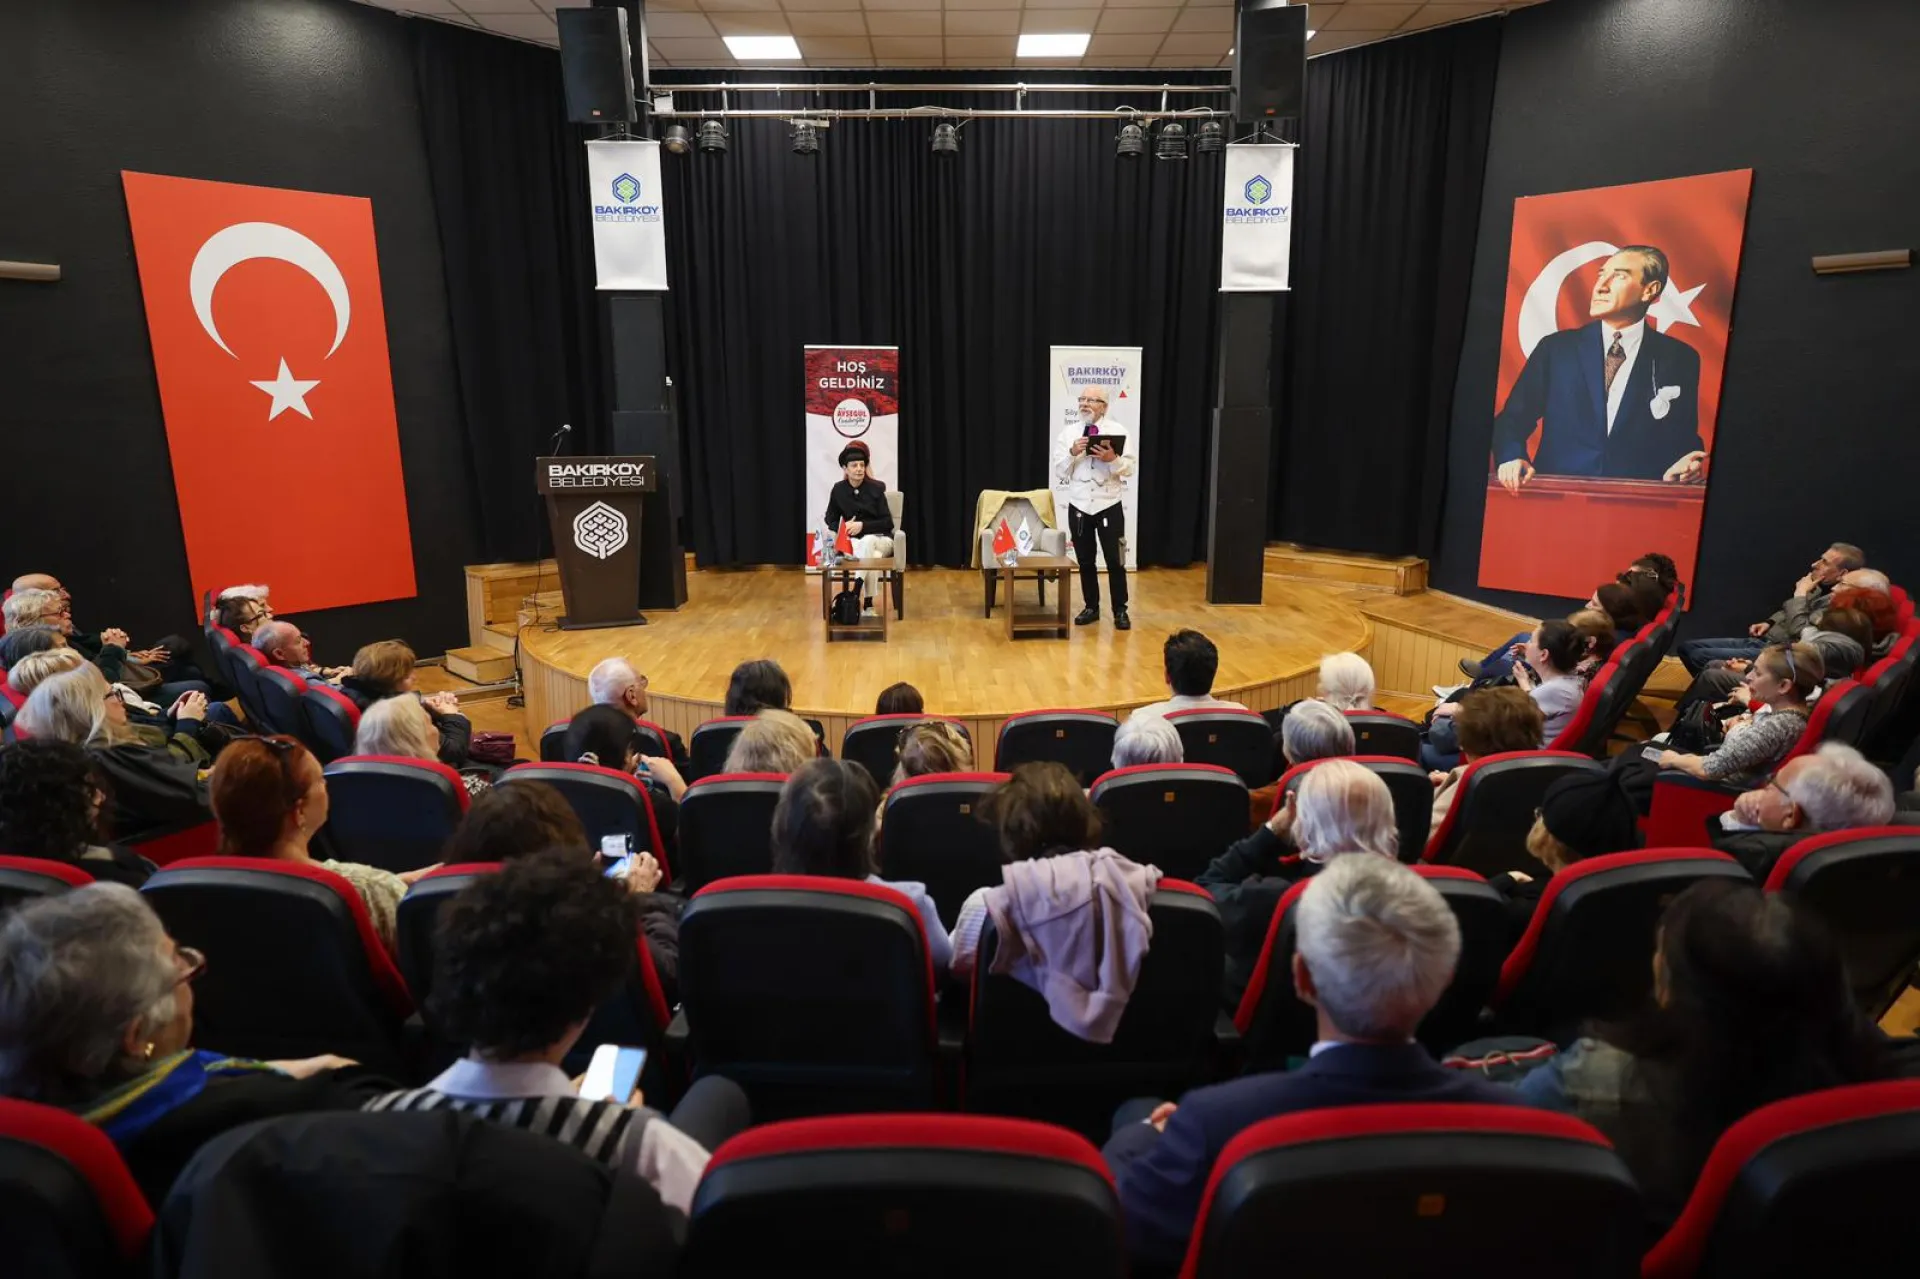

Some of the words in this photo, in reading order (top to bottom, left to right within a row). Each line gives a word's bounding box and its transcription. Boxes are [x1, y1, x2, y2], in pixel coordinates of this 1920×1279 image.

[837, 361, 866, 374] HOŞ
[1068, 366, 1126, 377] BAKIRKÖY
[819, 375, 884, 389] GELDİNİZ
[548, 463, 644, 476] BAKIRKÖY
